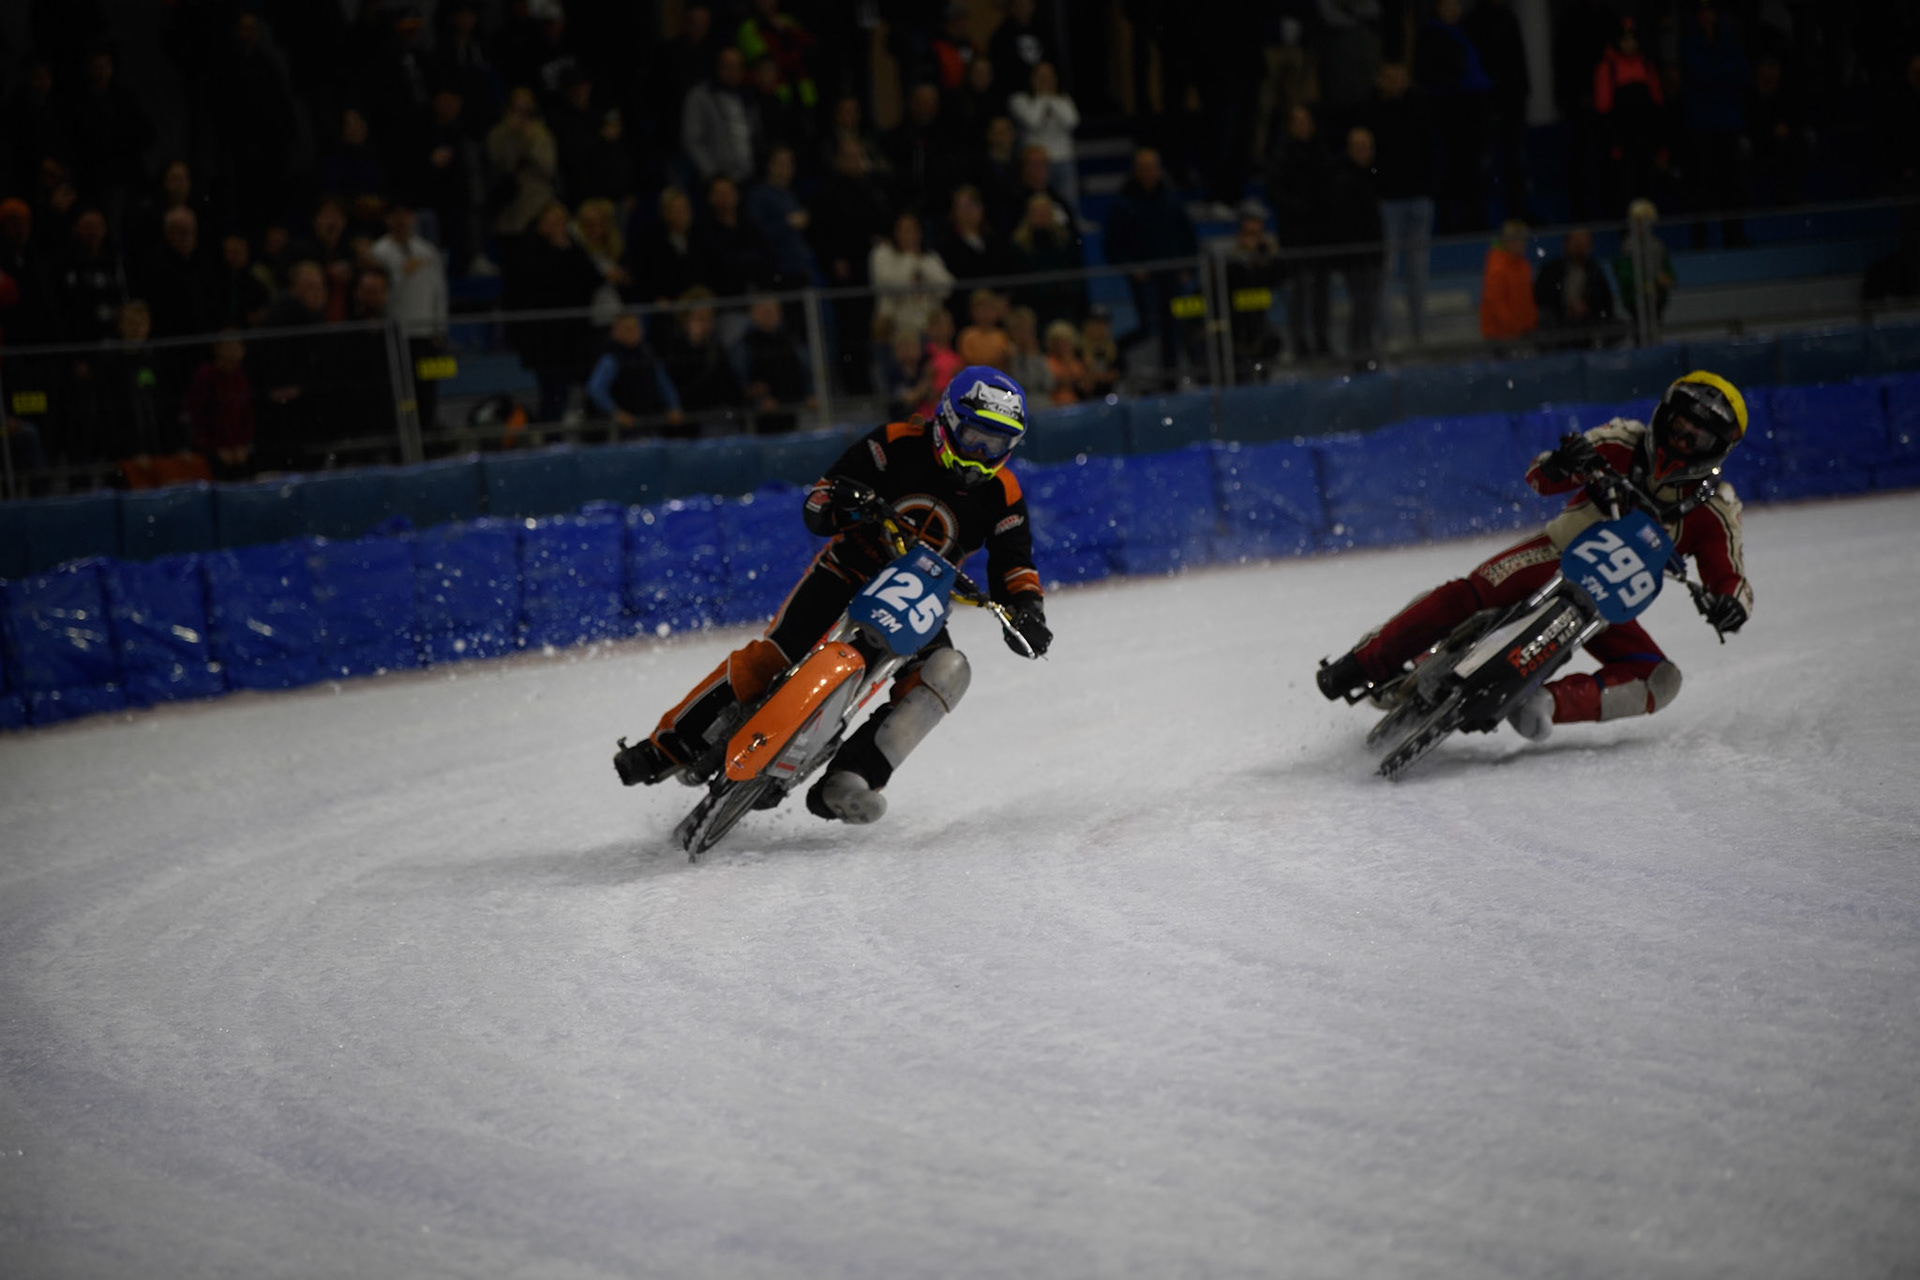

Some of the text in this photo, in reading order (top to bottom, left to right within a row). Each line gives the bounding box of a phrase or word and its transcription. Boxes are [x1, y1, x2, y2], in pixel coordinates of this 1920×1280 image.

[862, 566, 945, 634] 125
[1572, 528, 1656, 608] 299
[874, 608, 904, 634] FIM
